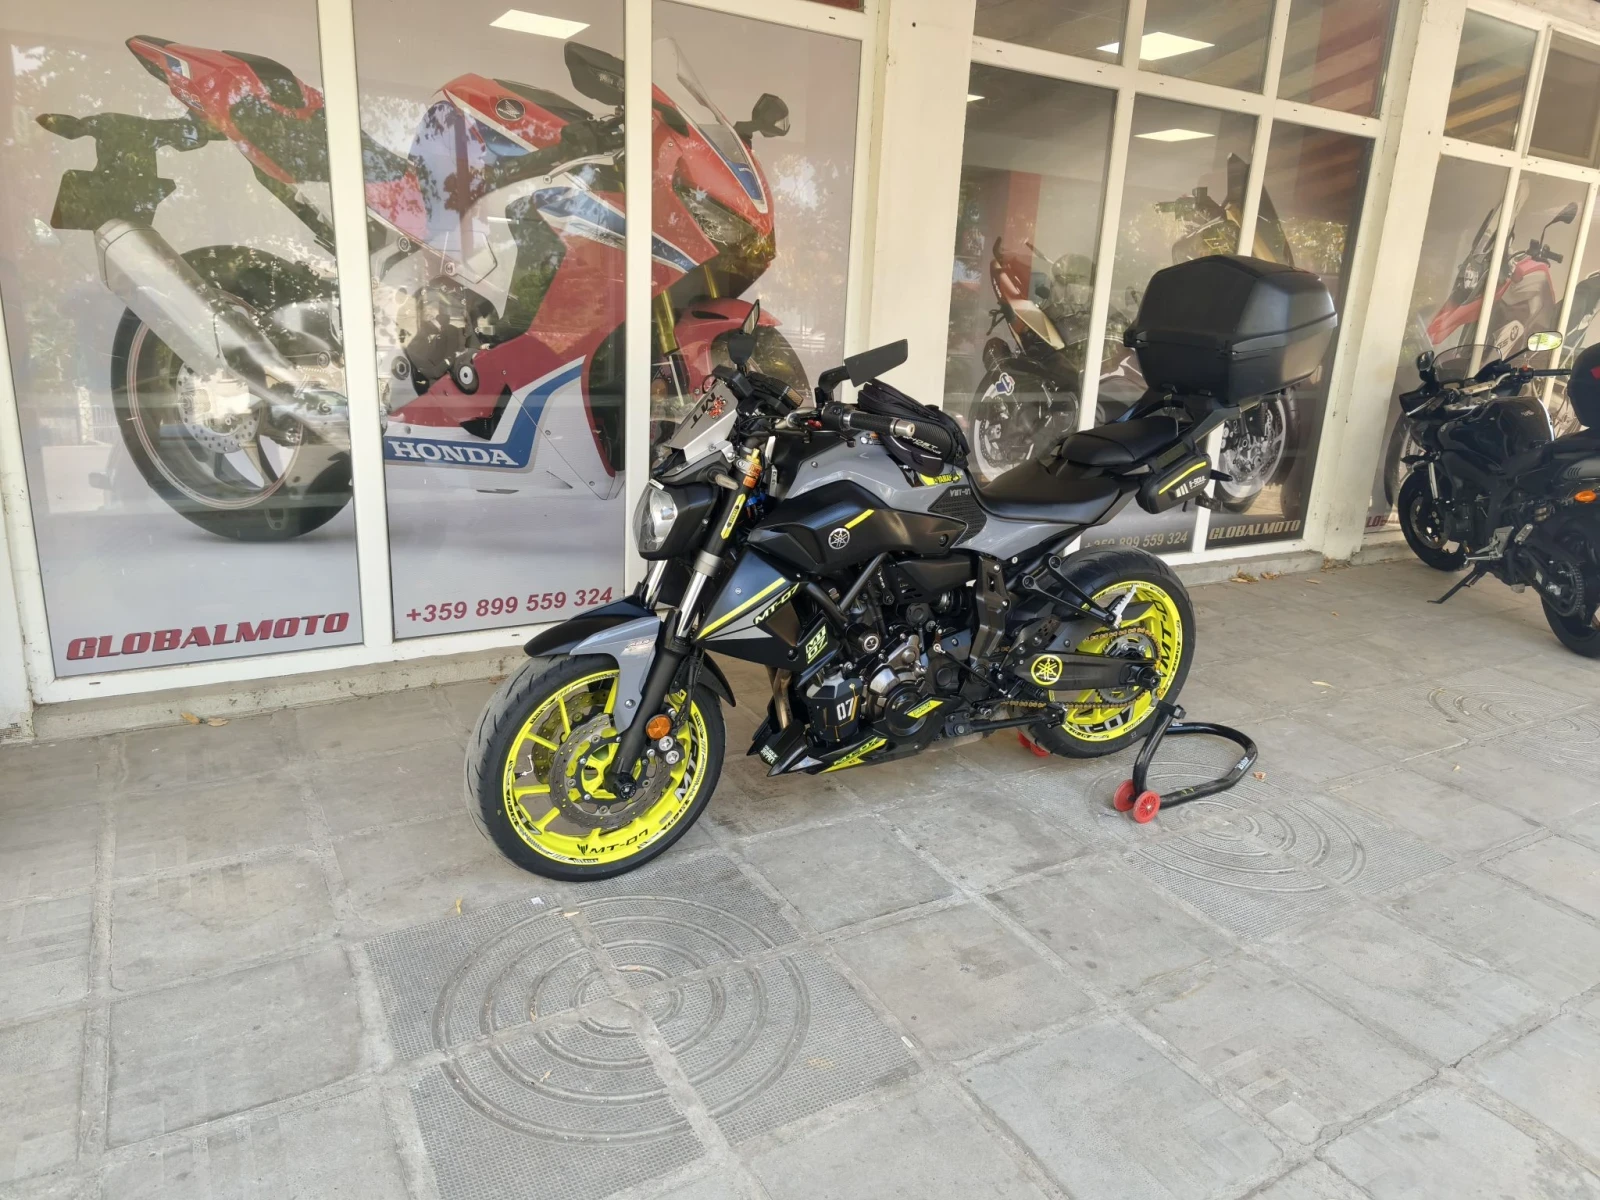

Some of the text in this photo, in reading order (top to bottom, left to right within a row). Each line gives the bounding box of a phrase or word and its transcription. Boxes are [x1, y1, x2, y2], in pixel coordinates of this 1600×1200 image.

[388, 440, 520, 466] HONDA
[1143, 533, 1164, 547] 559
[1167, 531, 1188, 545] 324
[1208, 519, 1301, 540] GLOBALMOTO
[406, 587, 613, 623] +359 899 559 324
[755, 582, 800, 624] MT-07
[66, 612, 350, 661] GLOBALMOTO
[836, 697, 854, 720] 07
[589, 828, 649, 854] MT-07
